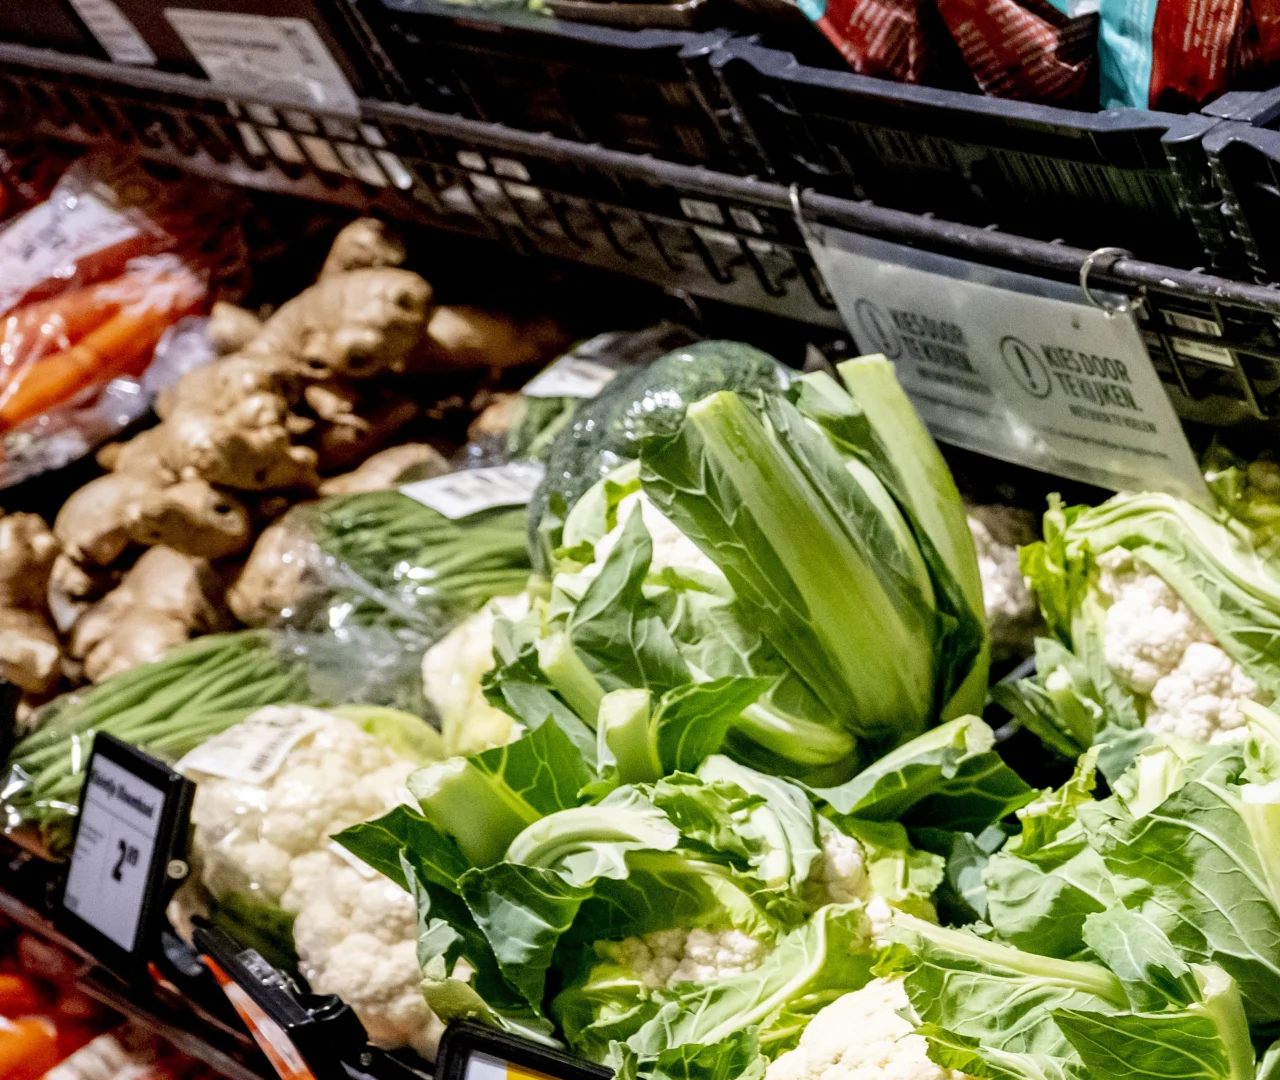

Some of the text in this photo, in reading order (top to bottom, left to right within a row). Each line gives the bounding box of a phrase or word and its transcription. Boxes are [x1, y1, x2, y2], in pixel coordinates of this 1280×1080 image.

[1040, 344, 1132, 384] KIES DOOR
[1053, 372, 1080, 398] TE
